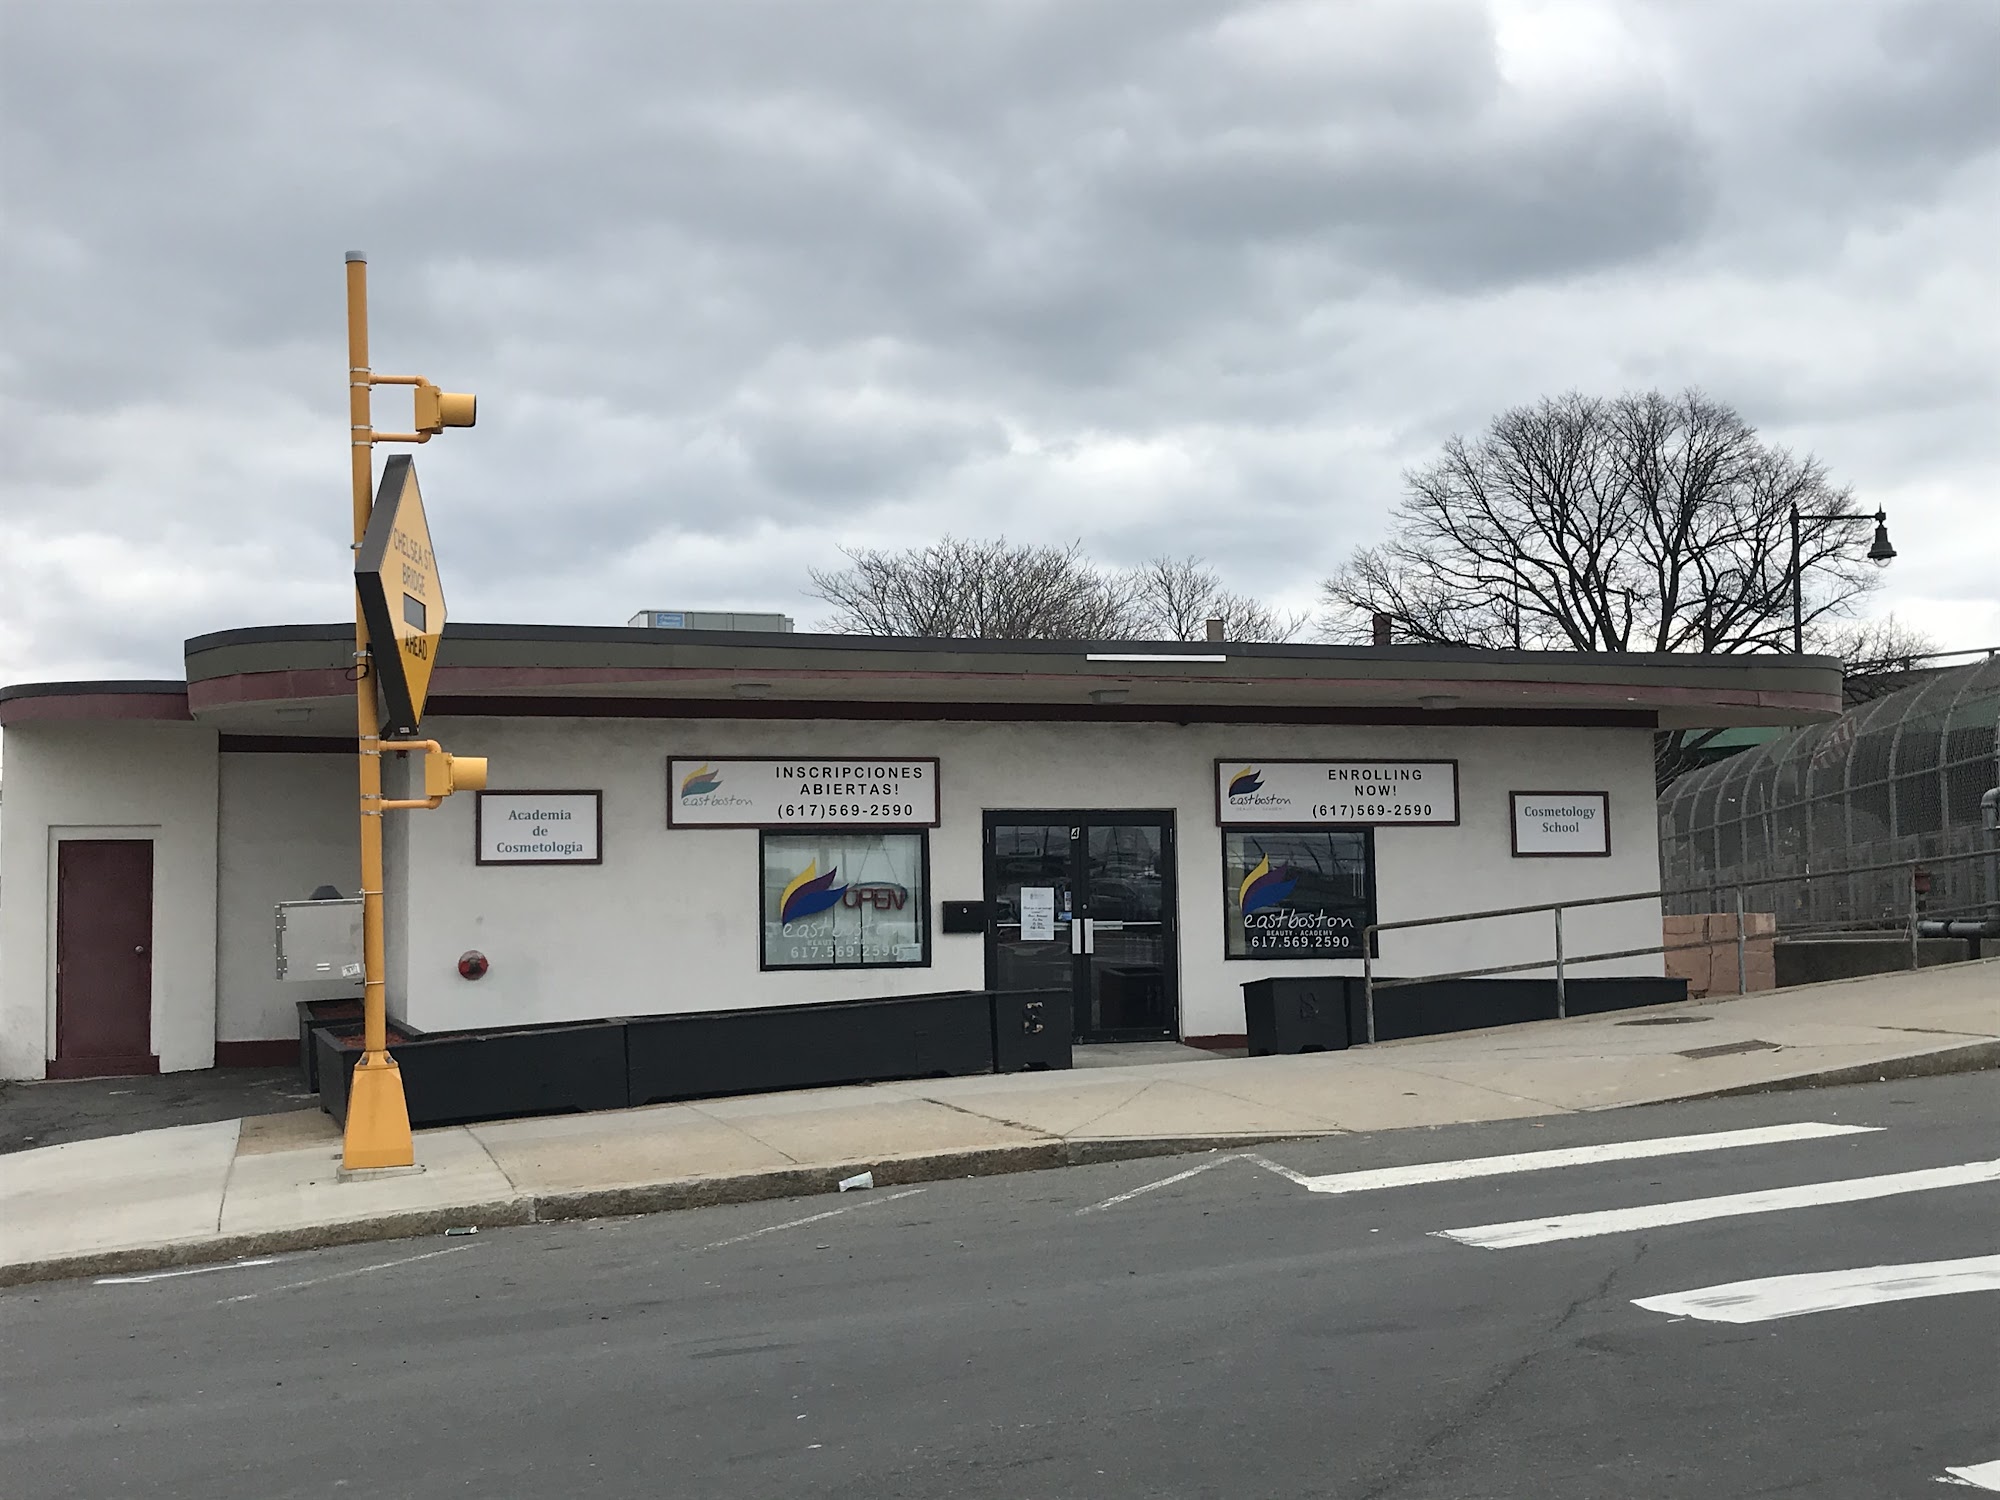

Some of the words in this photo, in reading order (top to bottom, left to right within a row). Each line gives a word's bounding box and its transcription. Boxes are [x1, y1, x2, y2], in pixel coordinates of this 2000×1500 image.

[393, 527, 424, 568] CHELSEA
[424, 548, 432, 571] ST
[402, 562, 426, 597] BRIDGE
[404, 629, 428, 661] AHEAD
[775, 766, 923, 779] INSCRIPCIONES
[1328, 769, 1422, 781] ENROLLING
[799, 783, 899, 796] ABIERTAS!
[1355, 785, 1397, 796] NOW!
[508, 809, 572, 821] Academia
[777, 804, 913, 819] (617)569-2590
[1312, 804, 1433, 819] (617)569-2590
[1524, 805, 1596, 820] Cosmetology
[532, 825, 548, 837] de
[1542, 821, 1580, 833] School
[496, 841, 583, 856] Cosmetologia
[842, 888, 906, 910] OPEN
[1266, 929, 1293, 937] BEAUTY
[1251, 936, 1350, 948] 617.569.2590
[790, 945, 899, 959] 617.569.2590
